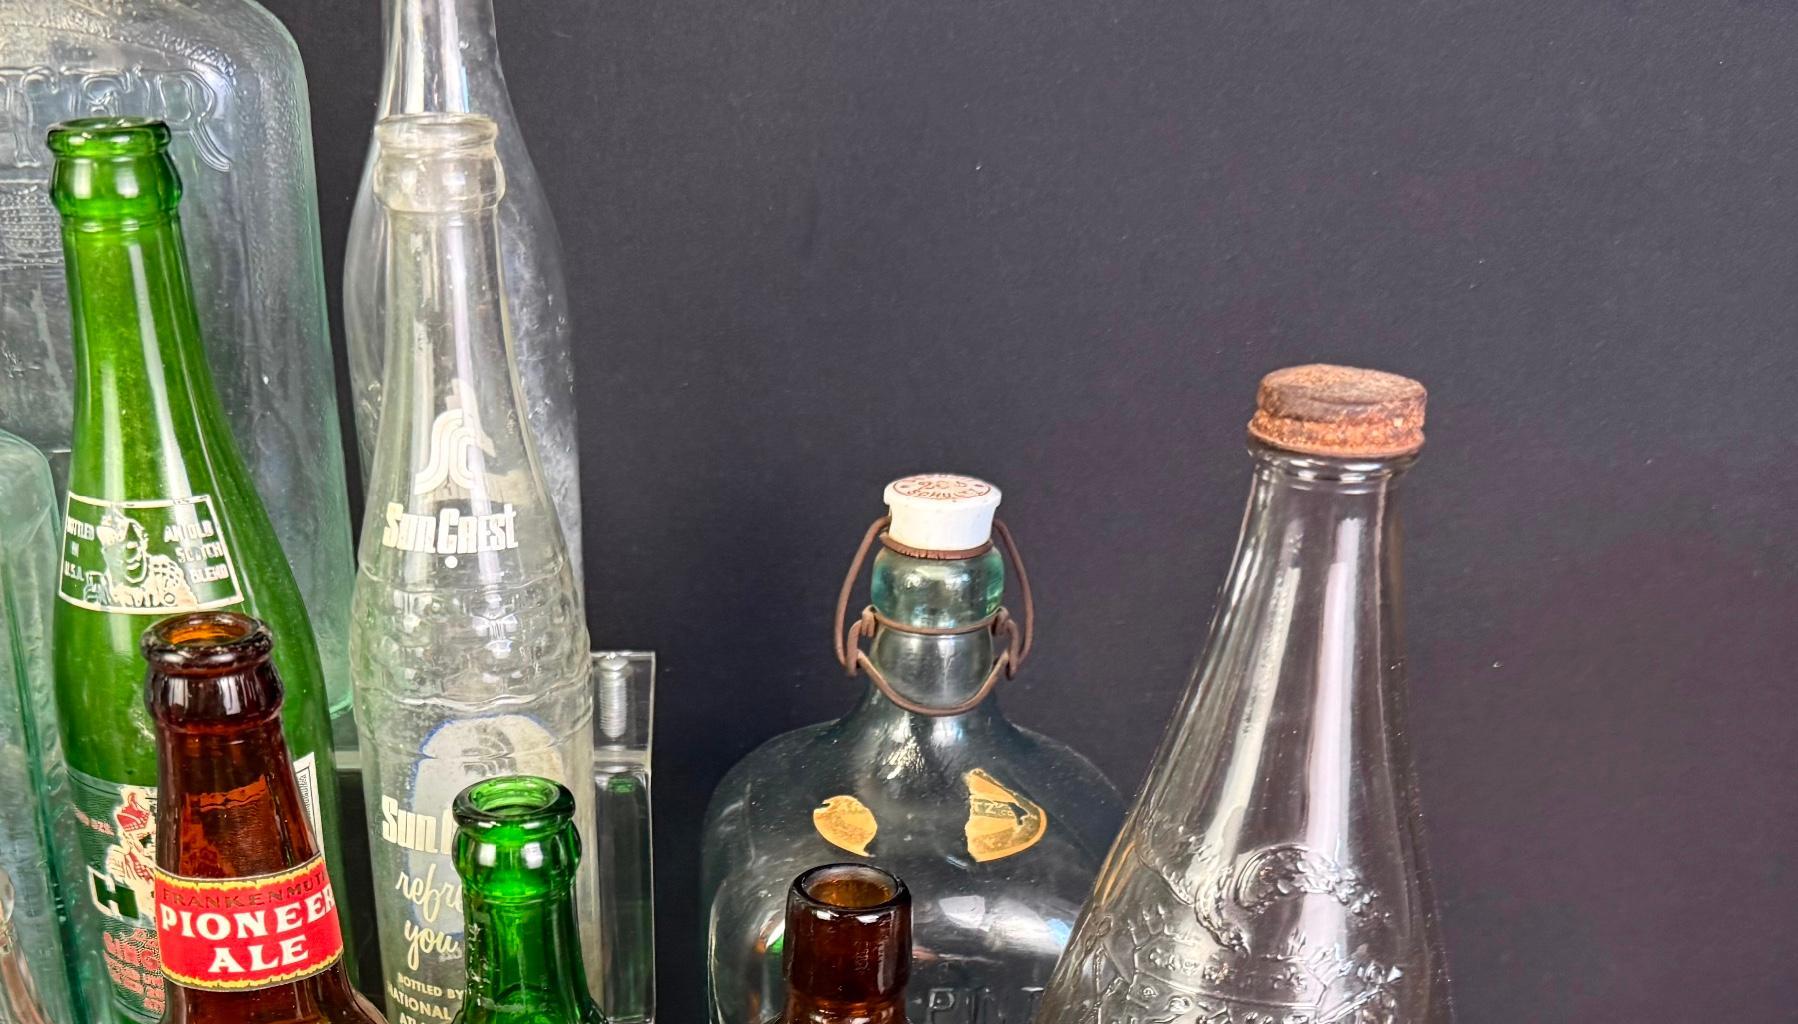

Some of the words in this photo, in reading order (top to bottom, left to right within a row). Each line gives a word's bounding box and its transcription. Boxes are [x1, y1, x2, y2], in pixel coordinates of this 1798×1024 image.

[160, 883, 335, 940] PIONEER
[208, 934, 309, 973] ALE
[403, 919, 459, 971] you
[397, 972, 442, 997] BOTTLED
[447, 988, 464, 1000] BY
